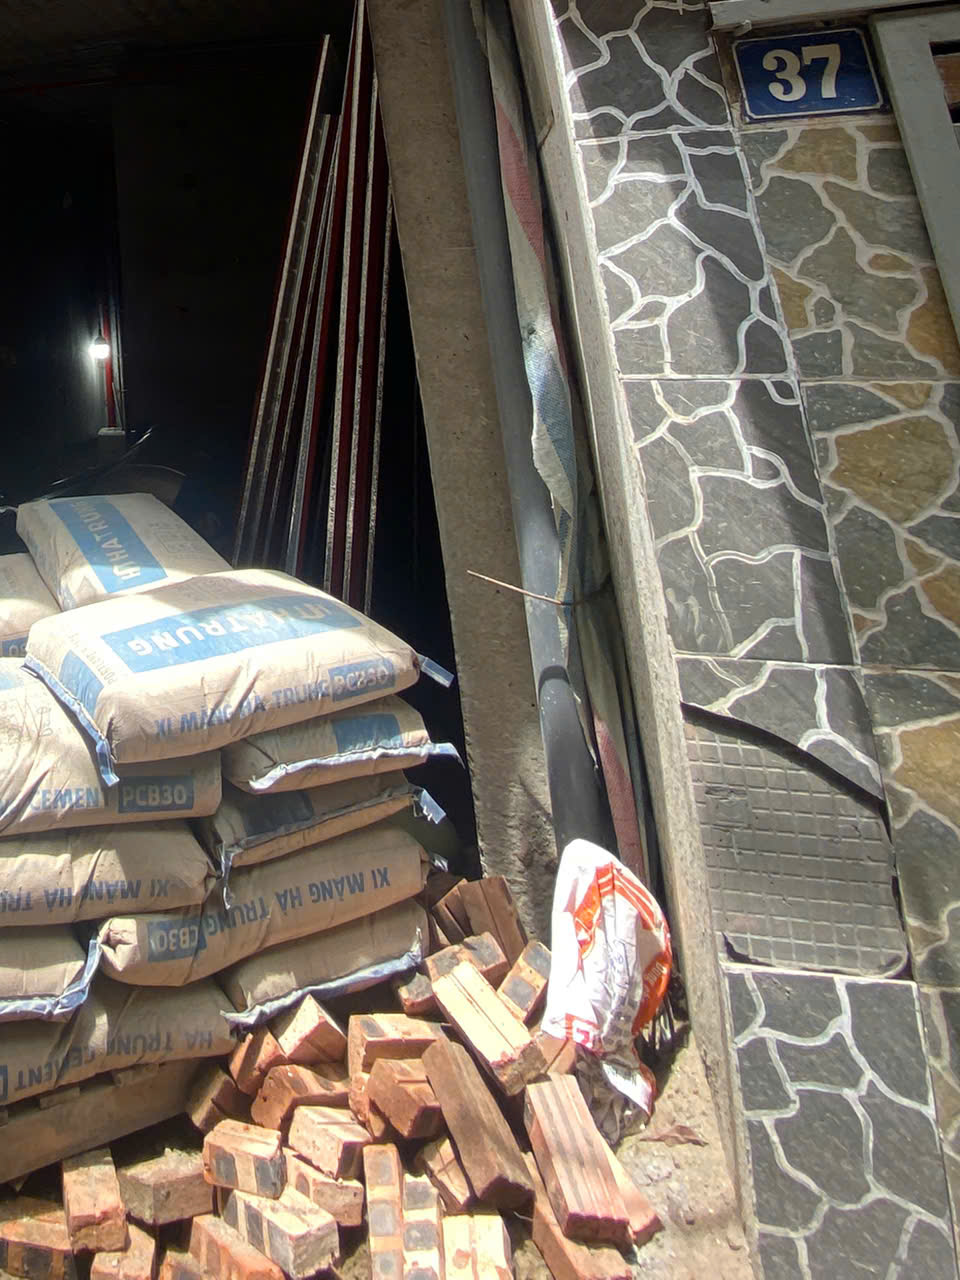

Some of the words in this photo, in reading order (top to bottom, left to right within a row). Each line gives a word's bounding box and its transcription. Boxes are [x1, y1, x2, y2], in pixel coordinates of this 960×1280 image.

[762, 42, 842, 102] 37
[154, 718, 171, 737] XI
[31, 787, 100, 812] CEMEN
[122, 784, 187, 807] PCB30
[150, 879, 169, 897] XI
[371, 867, 390, 889] XI
[204, 896, 270, 937] TRUNG
[157, 924, 199, 952] CB30
